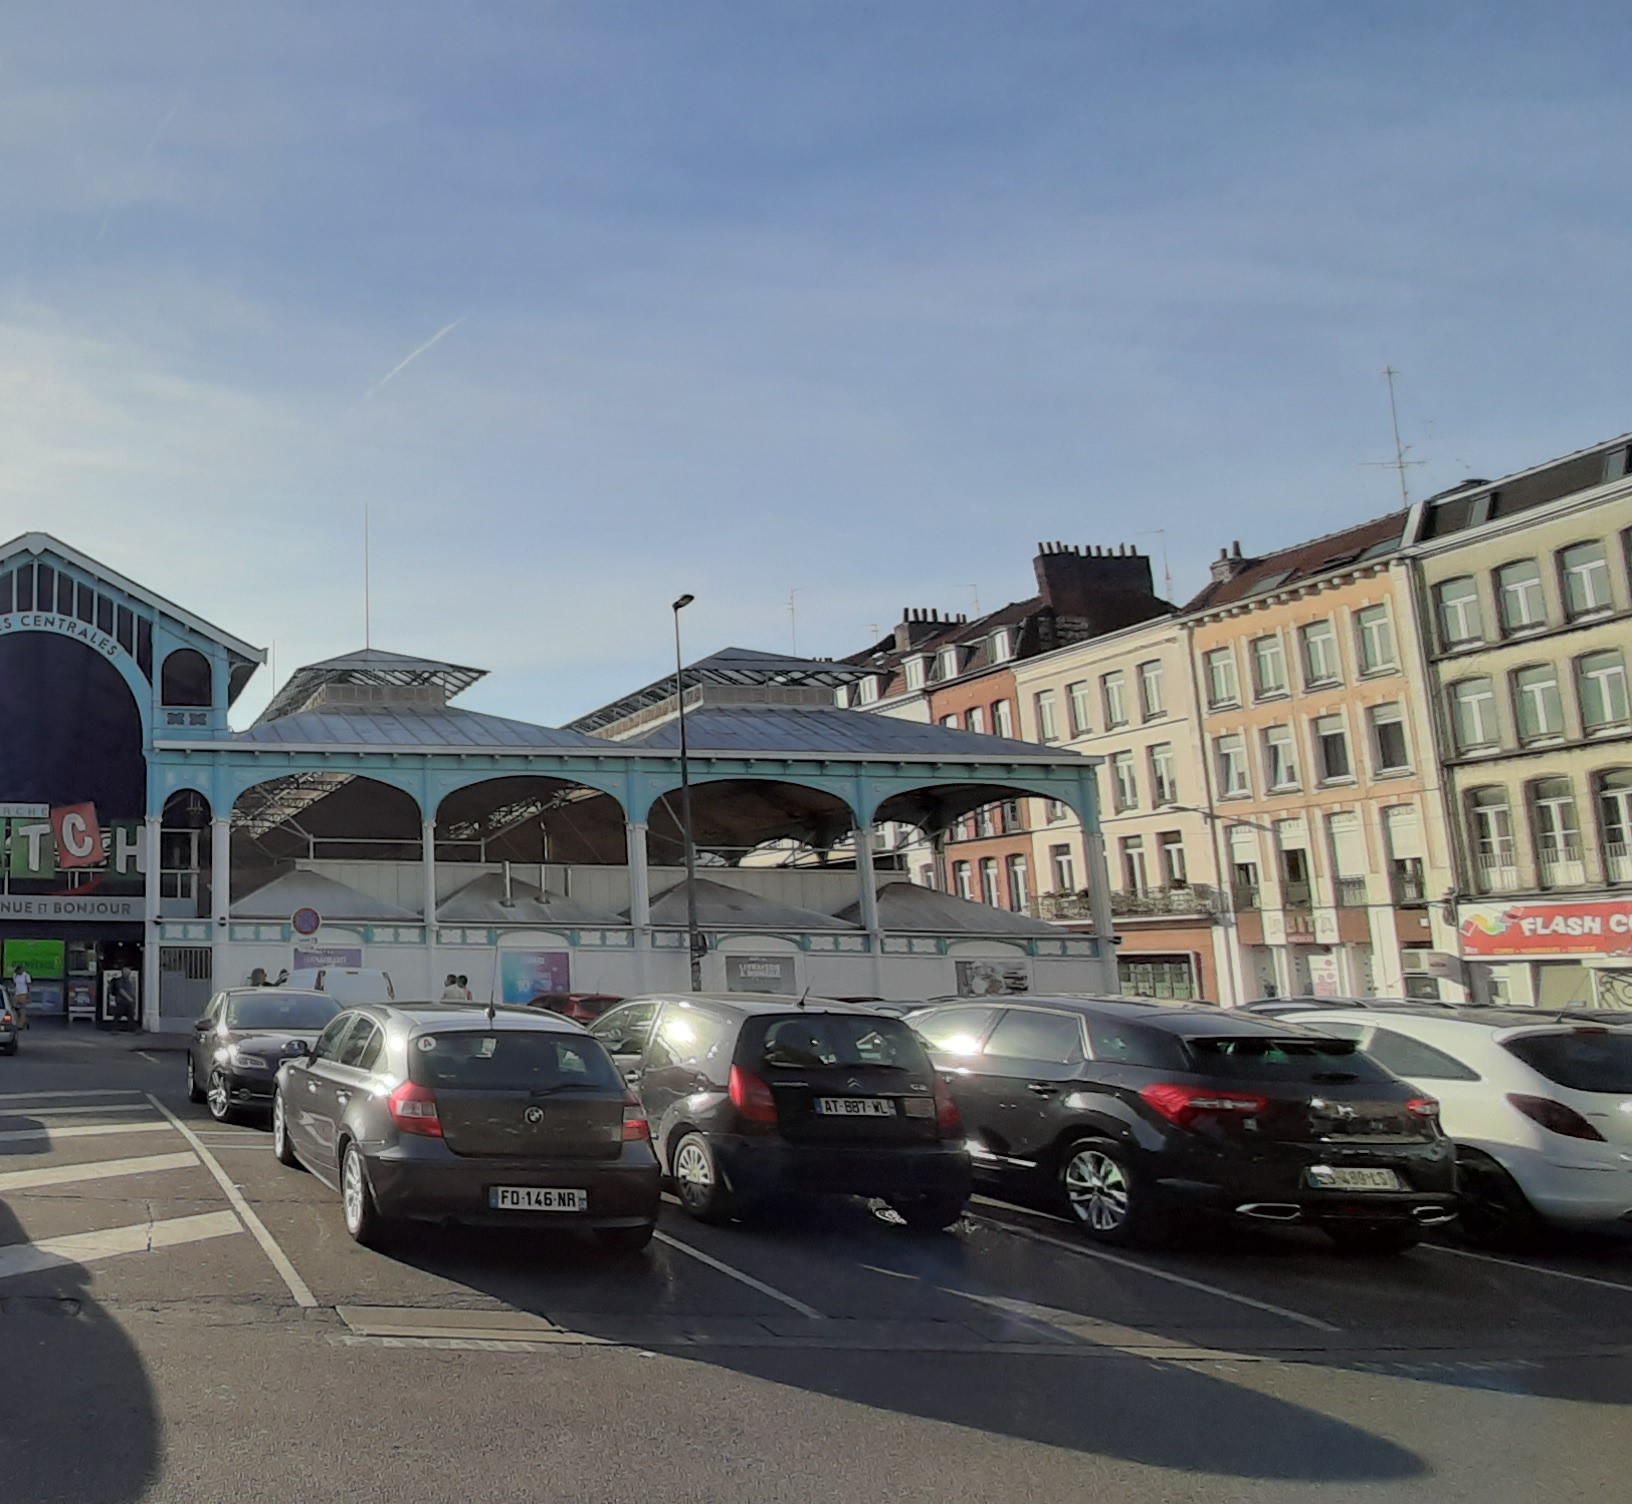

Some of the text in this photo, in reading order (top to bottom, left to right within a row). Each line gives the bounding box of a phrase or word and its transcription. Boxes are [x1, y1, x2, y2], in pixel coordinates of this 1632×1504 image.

[20, 615, 118, 656] CENTRALES
[38, 902, 48, 914] ET
[53, 902, 132, 916] BONJOUR
[1519, 913, 1632, 937] FLASH C
[500, 1189, 576, 1208] FD-146-NR
